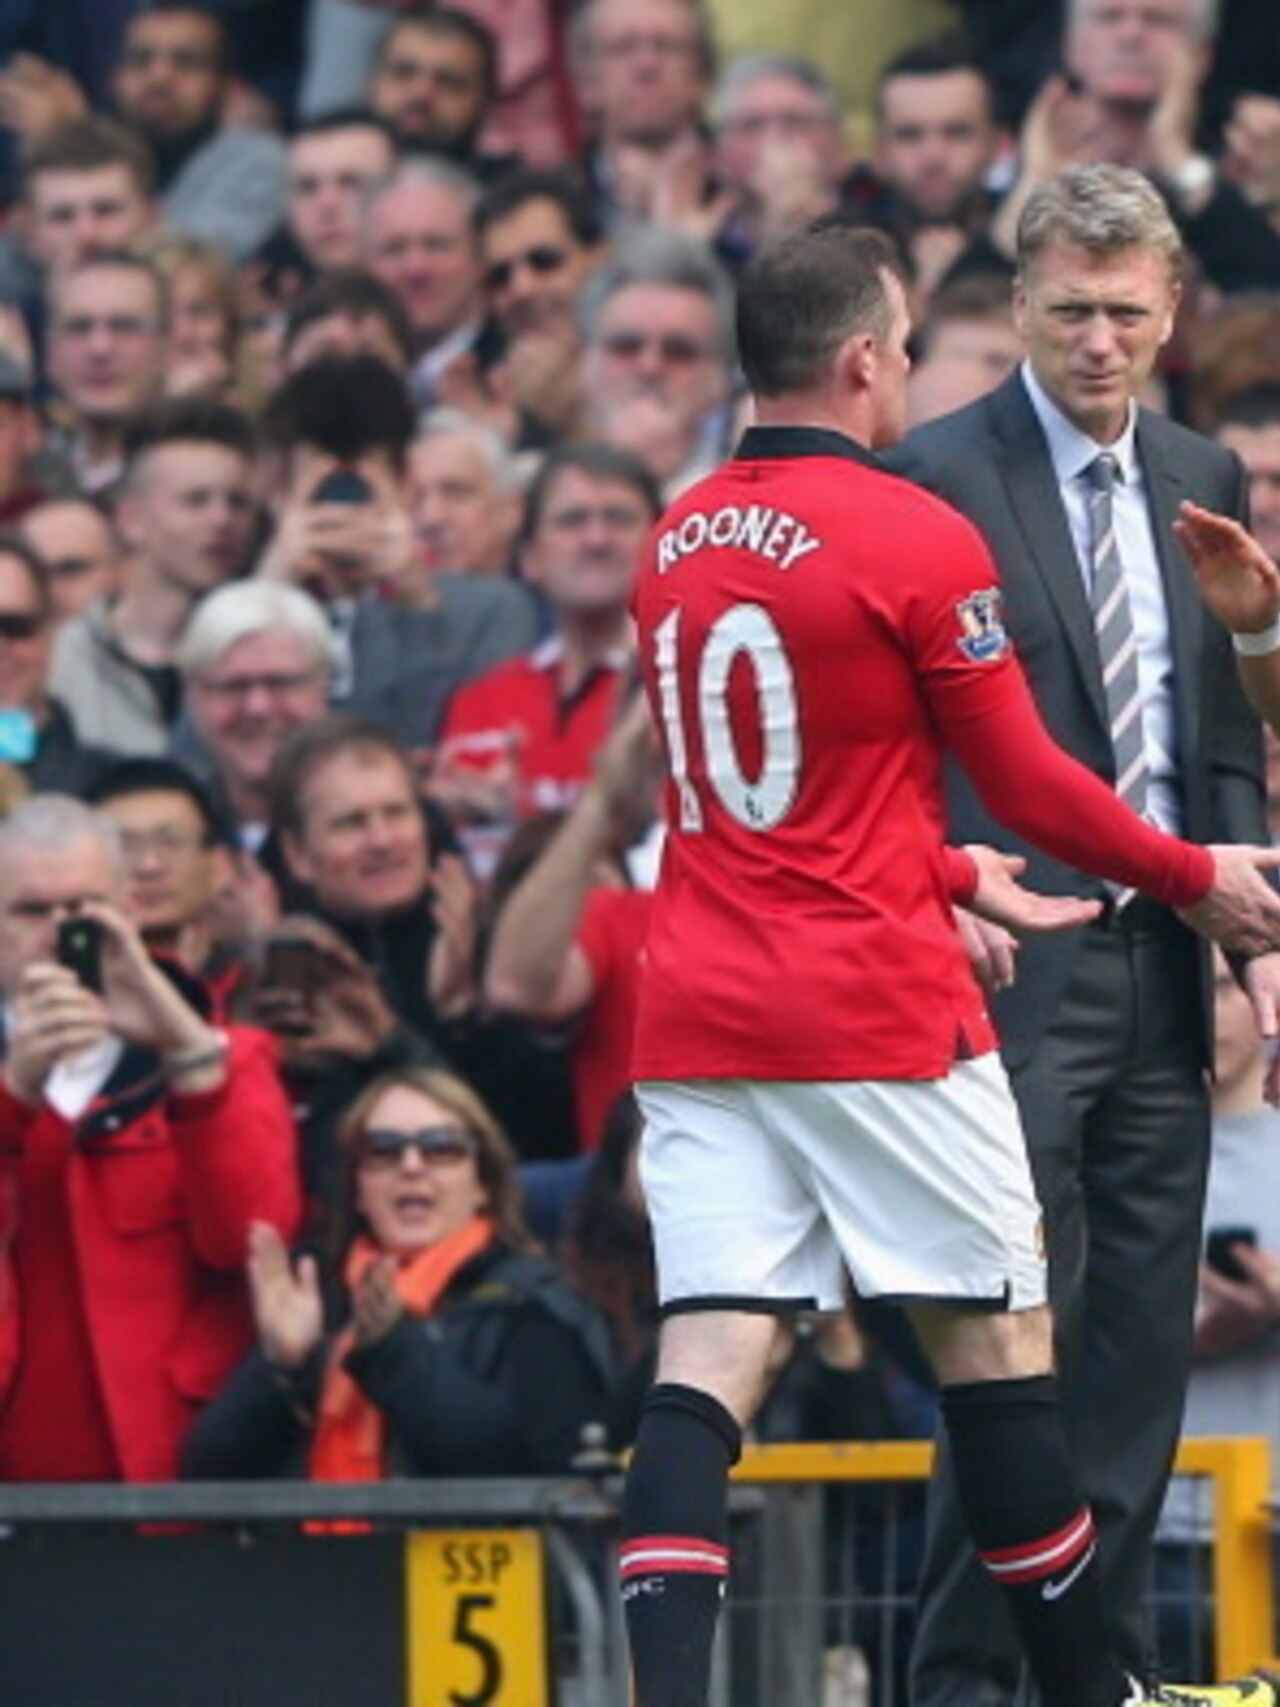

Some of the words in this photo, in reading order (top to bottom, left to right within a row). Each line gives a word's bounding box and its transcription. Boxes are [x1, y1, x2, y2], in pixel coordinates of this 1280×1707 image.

[658, 504, 822, 575] ROONEY
[654, 603, 801, 833] 10
[441, 1542, 511, 1584] SSP
[448, 1594, 505, 1707] 5
